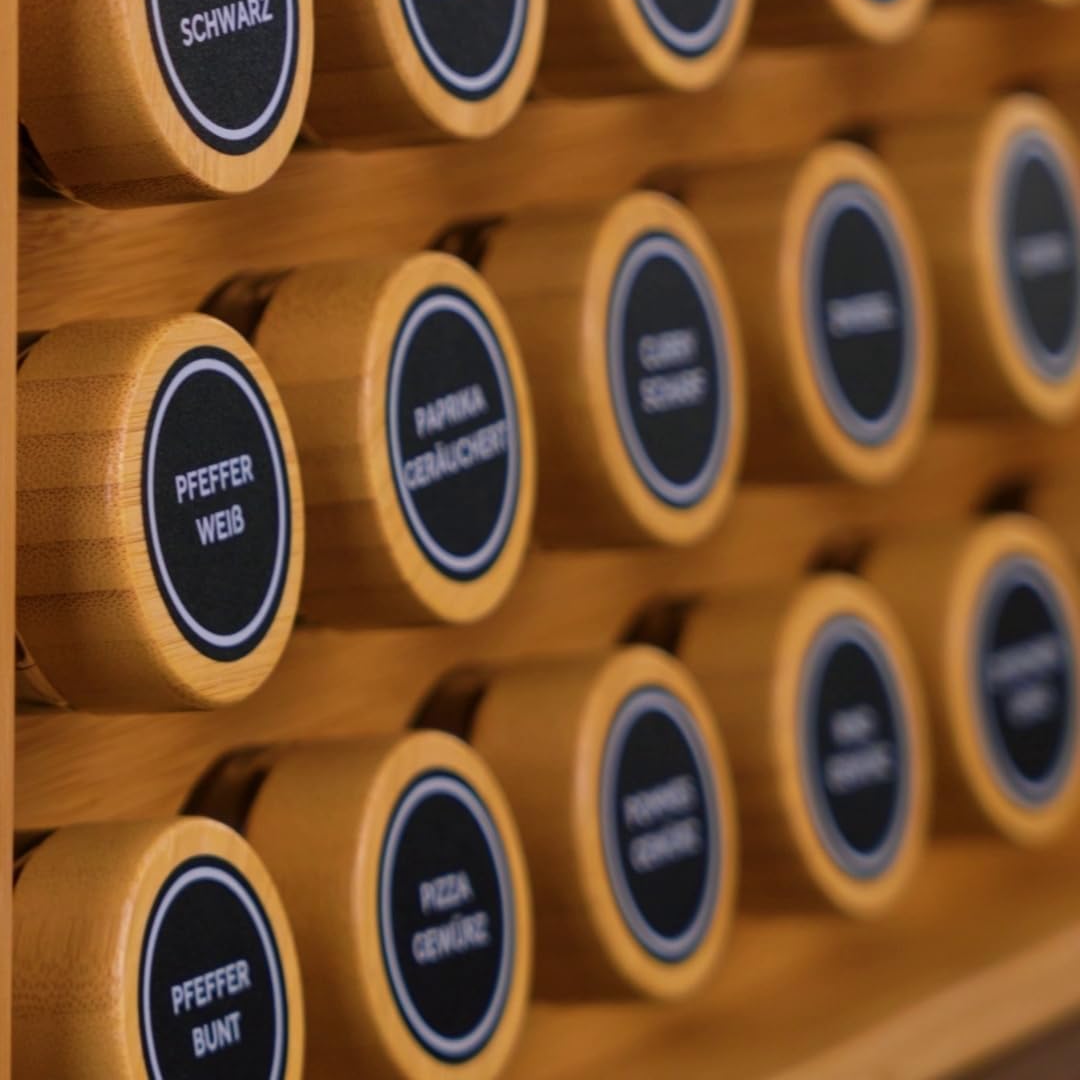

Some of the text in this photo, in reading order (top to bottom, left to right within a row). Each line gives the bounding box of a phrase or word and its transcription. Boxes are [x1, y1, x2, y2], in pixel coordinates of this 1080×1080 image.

[413, 384, 487, 437] PAPRIKA
[174, 454, 254, 504] PFEFFER
[402, 422, 507, 492] GERÄUCHERT
[418, 871, 475, 914] PIZZA
[411, 912, 491, 966] GEWÜRZ
[170, 959, 251, 1015] PFEFFER
[191, 1011, 242, 1058] BUNT
